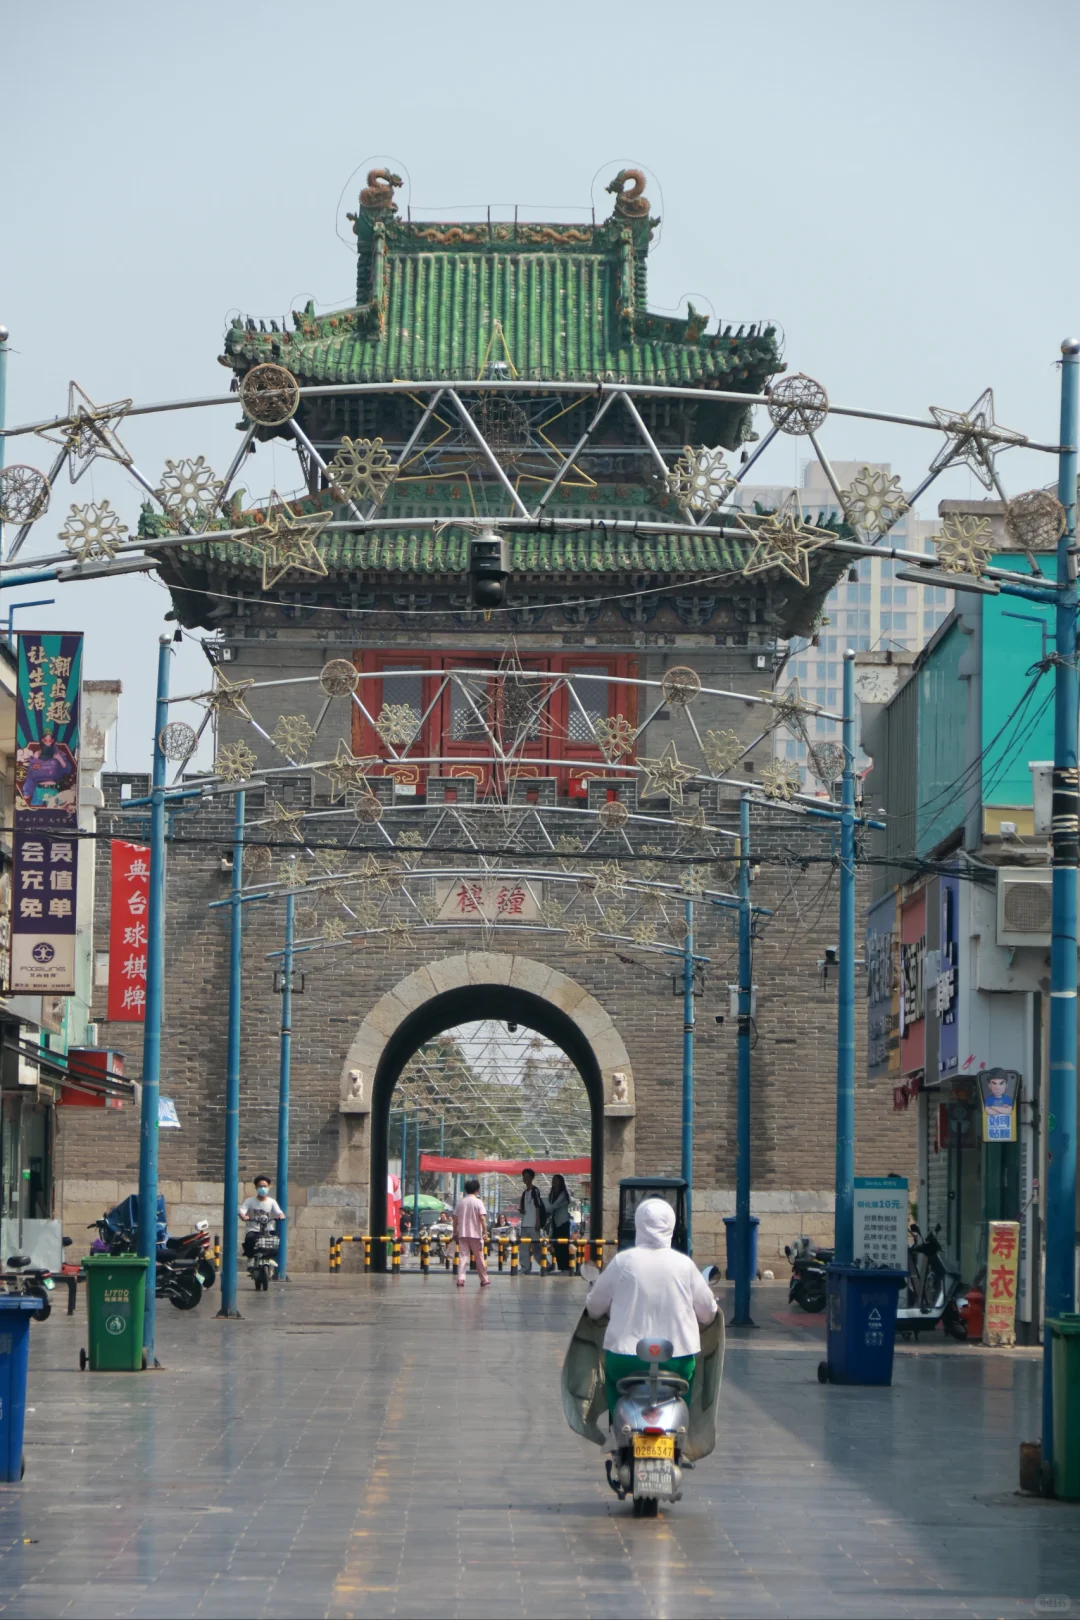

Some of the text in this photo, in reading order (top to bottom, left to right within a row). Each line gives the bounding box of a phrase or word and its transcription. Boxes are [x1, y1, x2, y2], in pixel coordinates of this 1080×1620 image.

[27, 646, 49, 711] 让生活
[46, 656, 72, 724] 潮出趣
[21, 842, 73, 862] 会员
[20, 870, 73, 890] 充值
[20, 898, 72, 918] 免单
[120, 842, 150, 1015] 典台球棋牌
[990, 1231, 1016, 1298] 寿衣
[635, 1446, 673, 1456] 0286347
